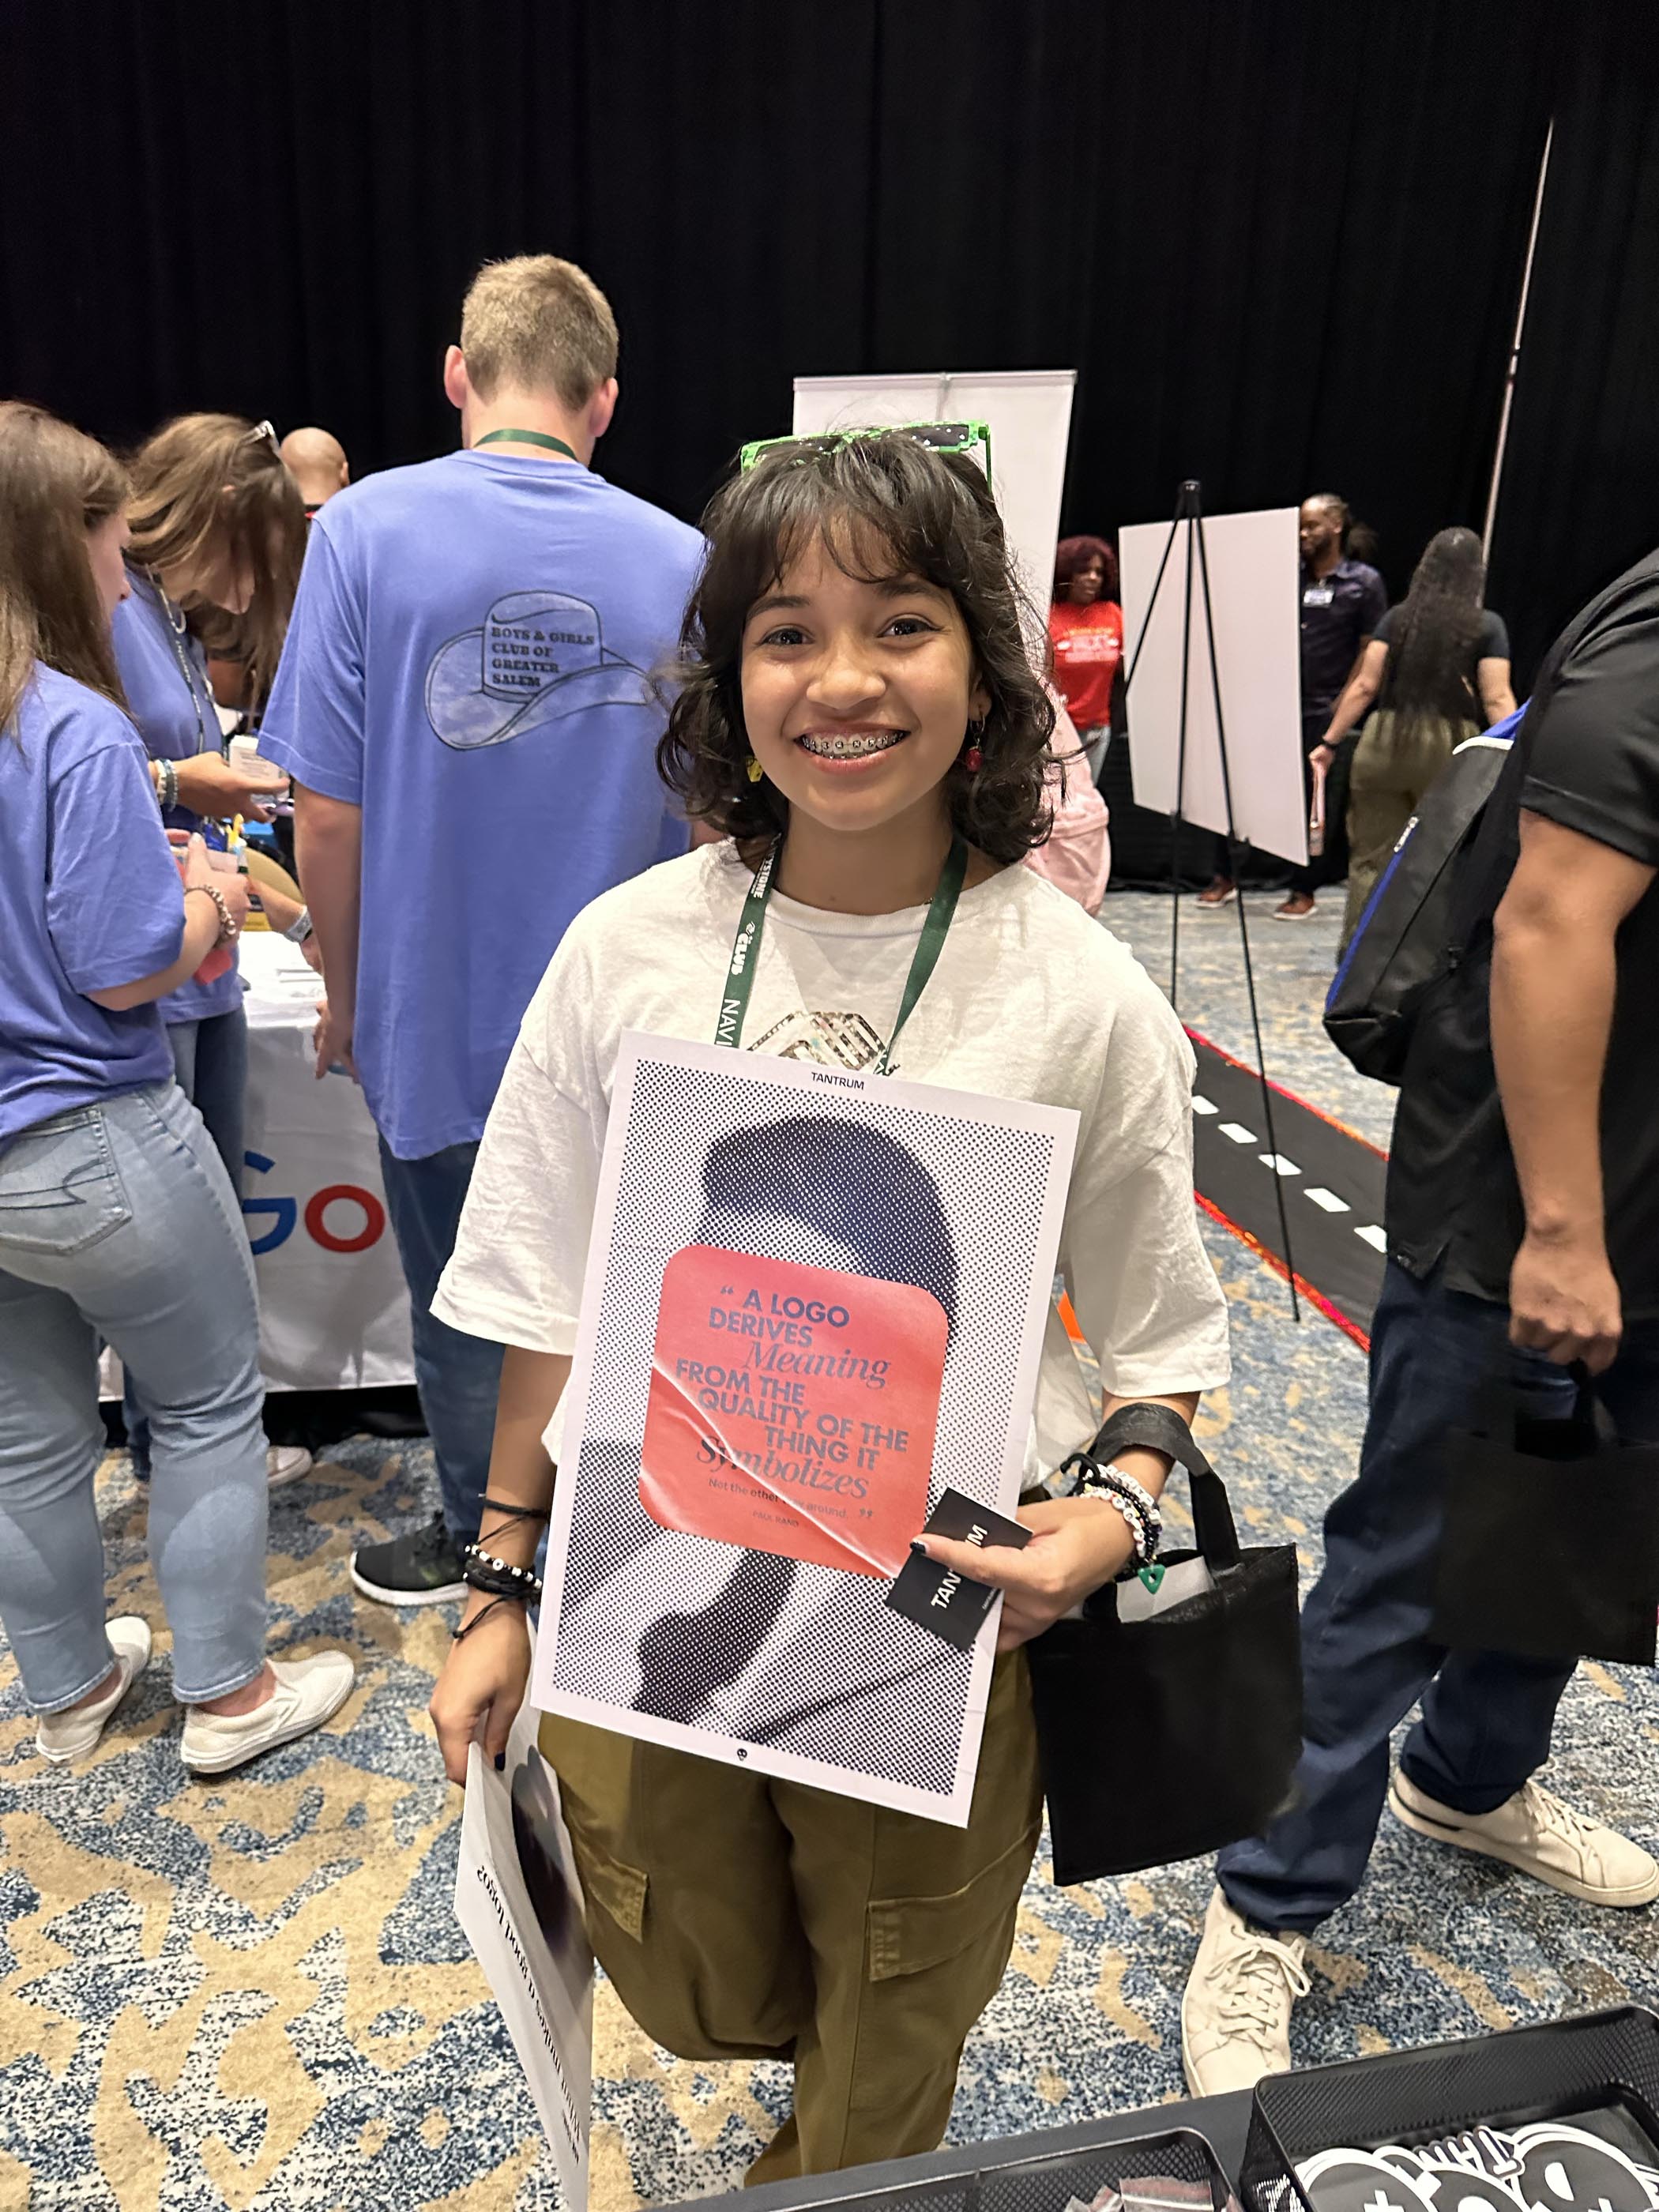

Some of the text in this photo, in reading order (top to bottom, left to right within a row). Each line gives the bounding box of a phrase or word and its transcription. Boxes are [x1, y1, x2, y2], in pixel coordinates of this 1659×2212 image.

[492, 627, 594, 645] BOYS & GIRLS
[492, 645, 530, 656] CLUB
[492, 659, 560, 674] GREATER
[492, 675, 541, 687] SALEM
[731, 933, 749, 976] CLUB
[811, 1071, 865, 1091] TANTRUM
[709, 1307, 813, 1348] DERIVES
[743, 1288, 762, 1312] A
[770, 1292, 850, 1327] LOGO
[676, 1358, 806, 1406] FROM THE
[746, 1341, 892, 1390] Meaning
[698, 1387, 909, 1453] QUALITY OF THE
[765, 1425, 881, 1471] THING IT
[709, 1478, 728, 1492] Not
[730, 1481, 749, 1495] the
[750, 1489, 780, 1503] other
[477, 1865, 504, 1925] logo?
[506, 1921, 528, 1980] good
